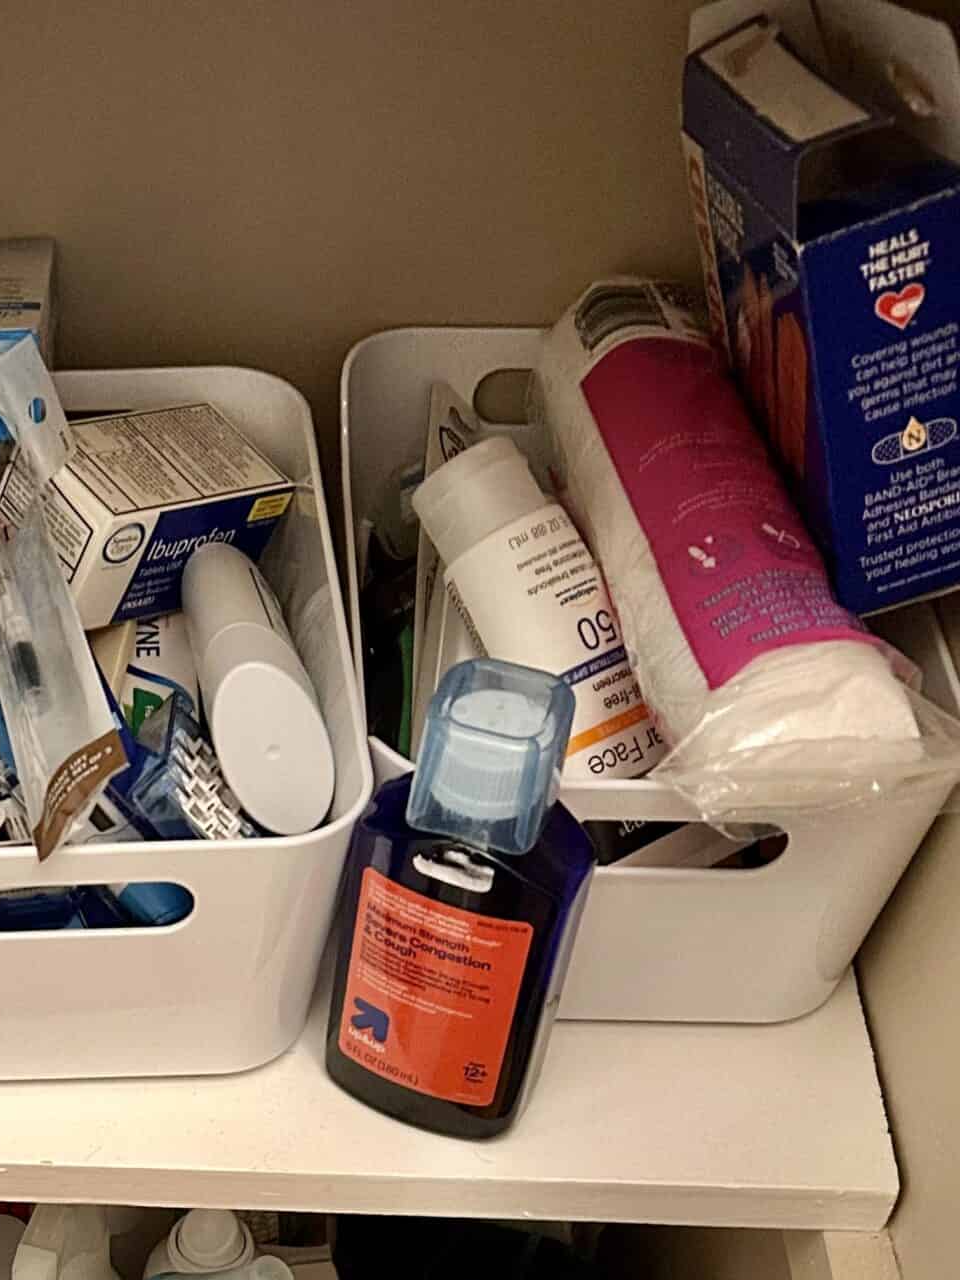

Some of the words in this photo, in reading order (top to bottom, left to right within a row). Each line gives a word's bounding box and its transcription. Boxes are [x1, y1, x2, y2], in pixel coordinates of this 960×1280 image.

[869, 228, 919, 258] HEALS
[860, 255, 889, 278] THE
[869, 260, 925, 292] FASTER
[889, 466, 913, 483] Use
[915, 457, 945, 475] both
[866, 516, 891, 532] and
[866, 528, 894, 546] First
[895, 520, 918, 536] Aid
[147, 528, 236, 561] Ibuprofen
[859, 544, 904, 568] Trusted
[865, 562, 892, 581] your
[894, 546, 939, 571] healing
[573, 607, 618, 652] 50
[585, 734, 645, 776] Face
[366, 901, 417, 935] Maximum
[418, 928, 471, 954] Strength
[374, 928, 418, 959] Cough
[409, 933, 492, 971] Congestion
